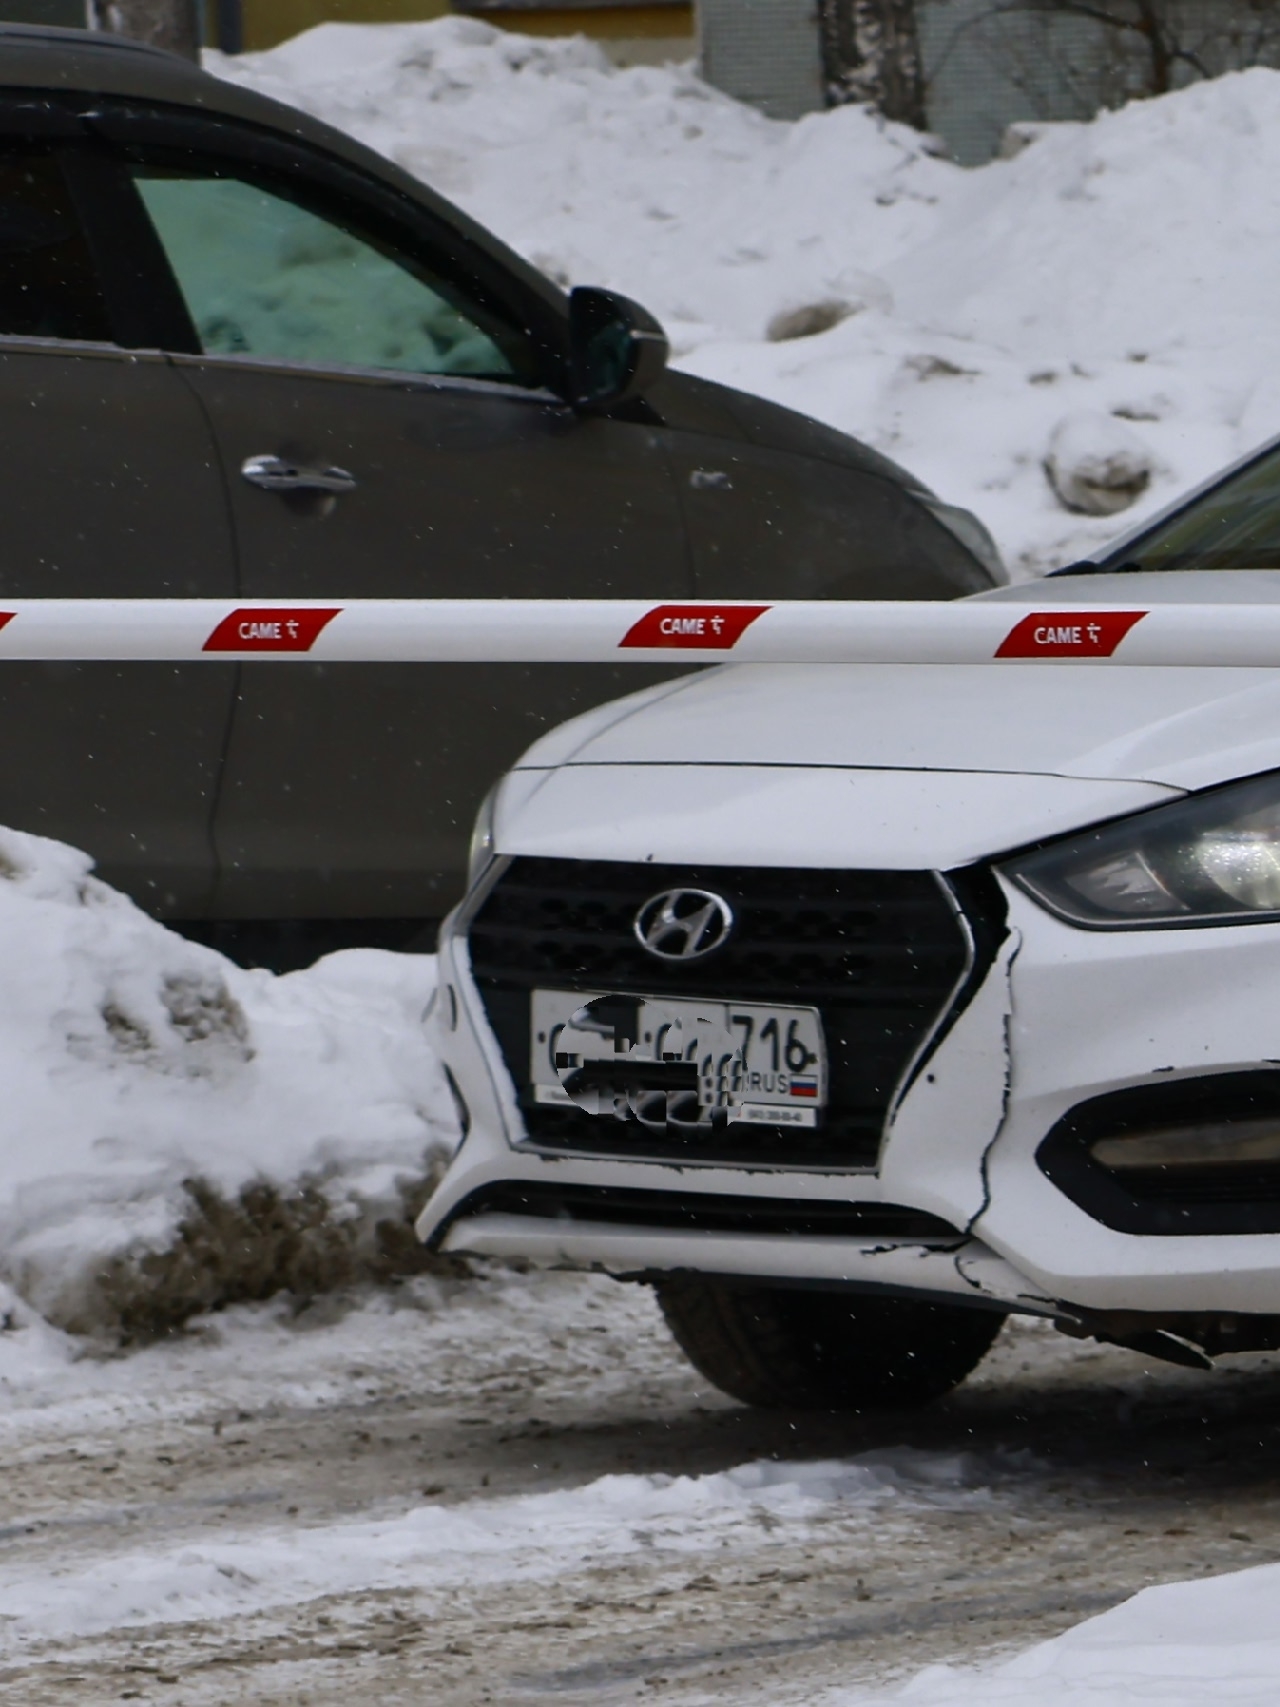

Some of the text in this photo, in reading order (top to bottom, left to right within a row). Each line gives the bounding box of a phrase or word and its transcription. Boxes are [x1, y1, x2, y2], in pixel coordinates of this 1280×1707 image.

[239, 622, 282, 640] CAME
[660, 618, 706, 635] CAME
[1034, 626, 1083, 644] CAME
[732, 1014, 809, 1073] 716
[750, 1072, 788, 1094] RUS
